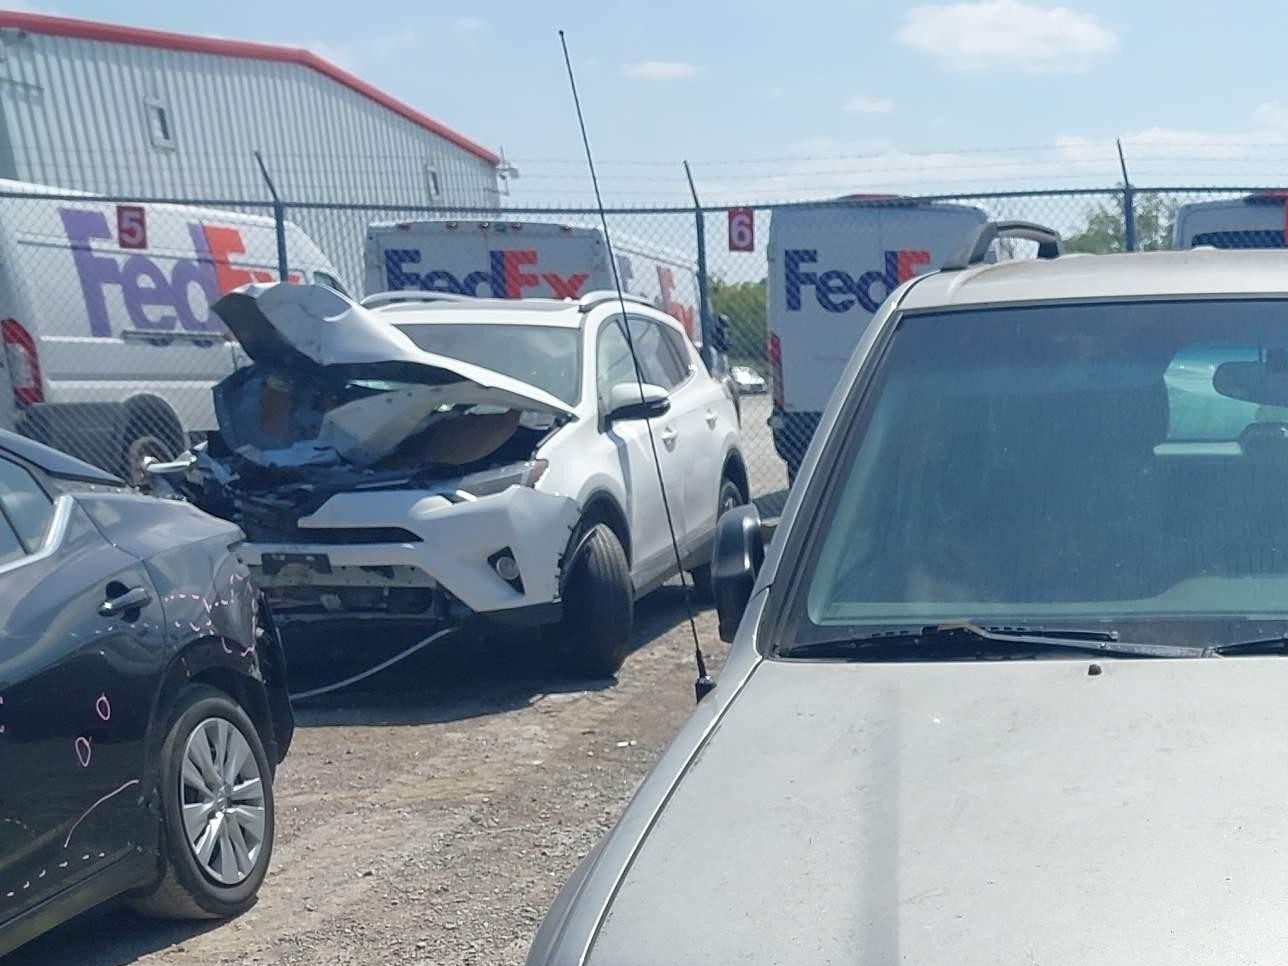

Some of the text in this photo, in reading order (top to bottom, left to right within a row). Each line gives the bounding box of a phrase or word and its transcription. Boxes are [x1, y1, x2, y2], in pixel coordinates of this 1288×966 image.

[121, 211, 144, 246] 5
[731, 215, 752, 248] 6
[58, 208, 300, 346] FedE
[785, 250, 930, 314] Fed
